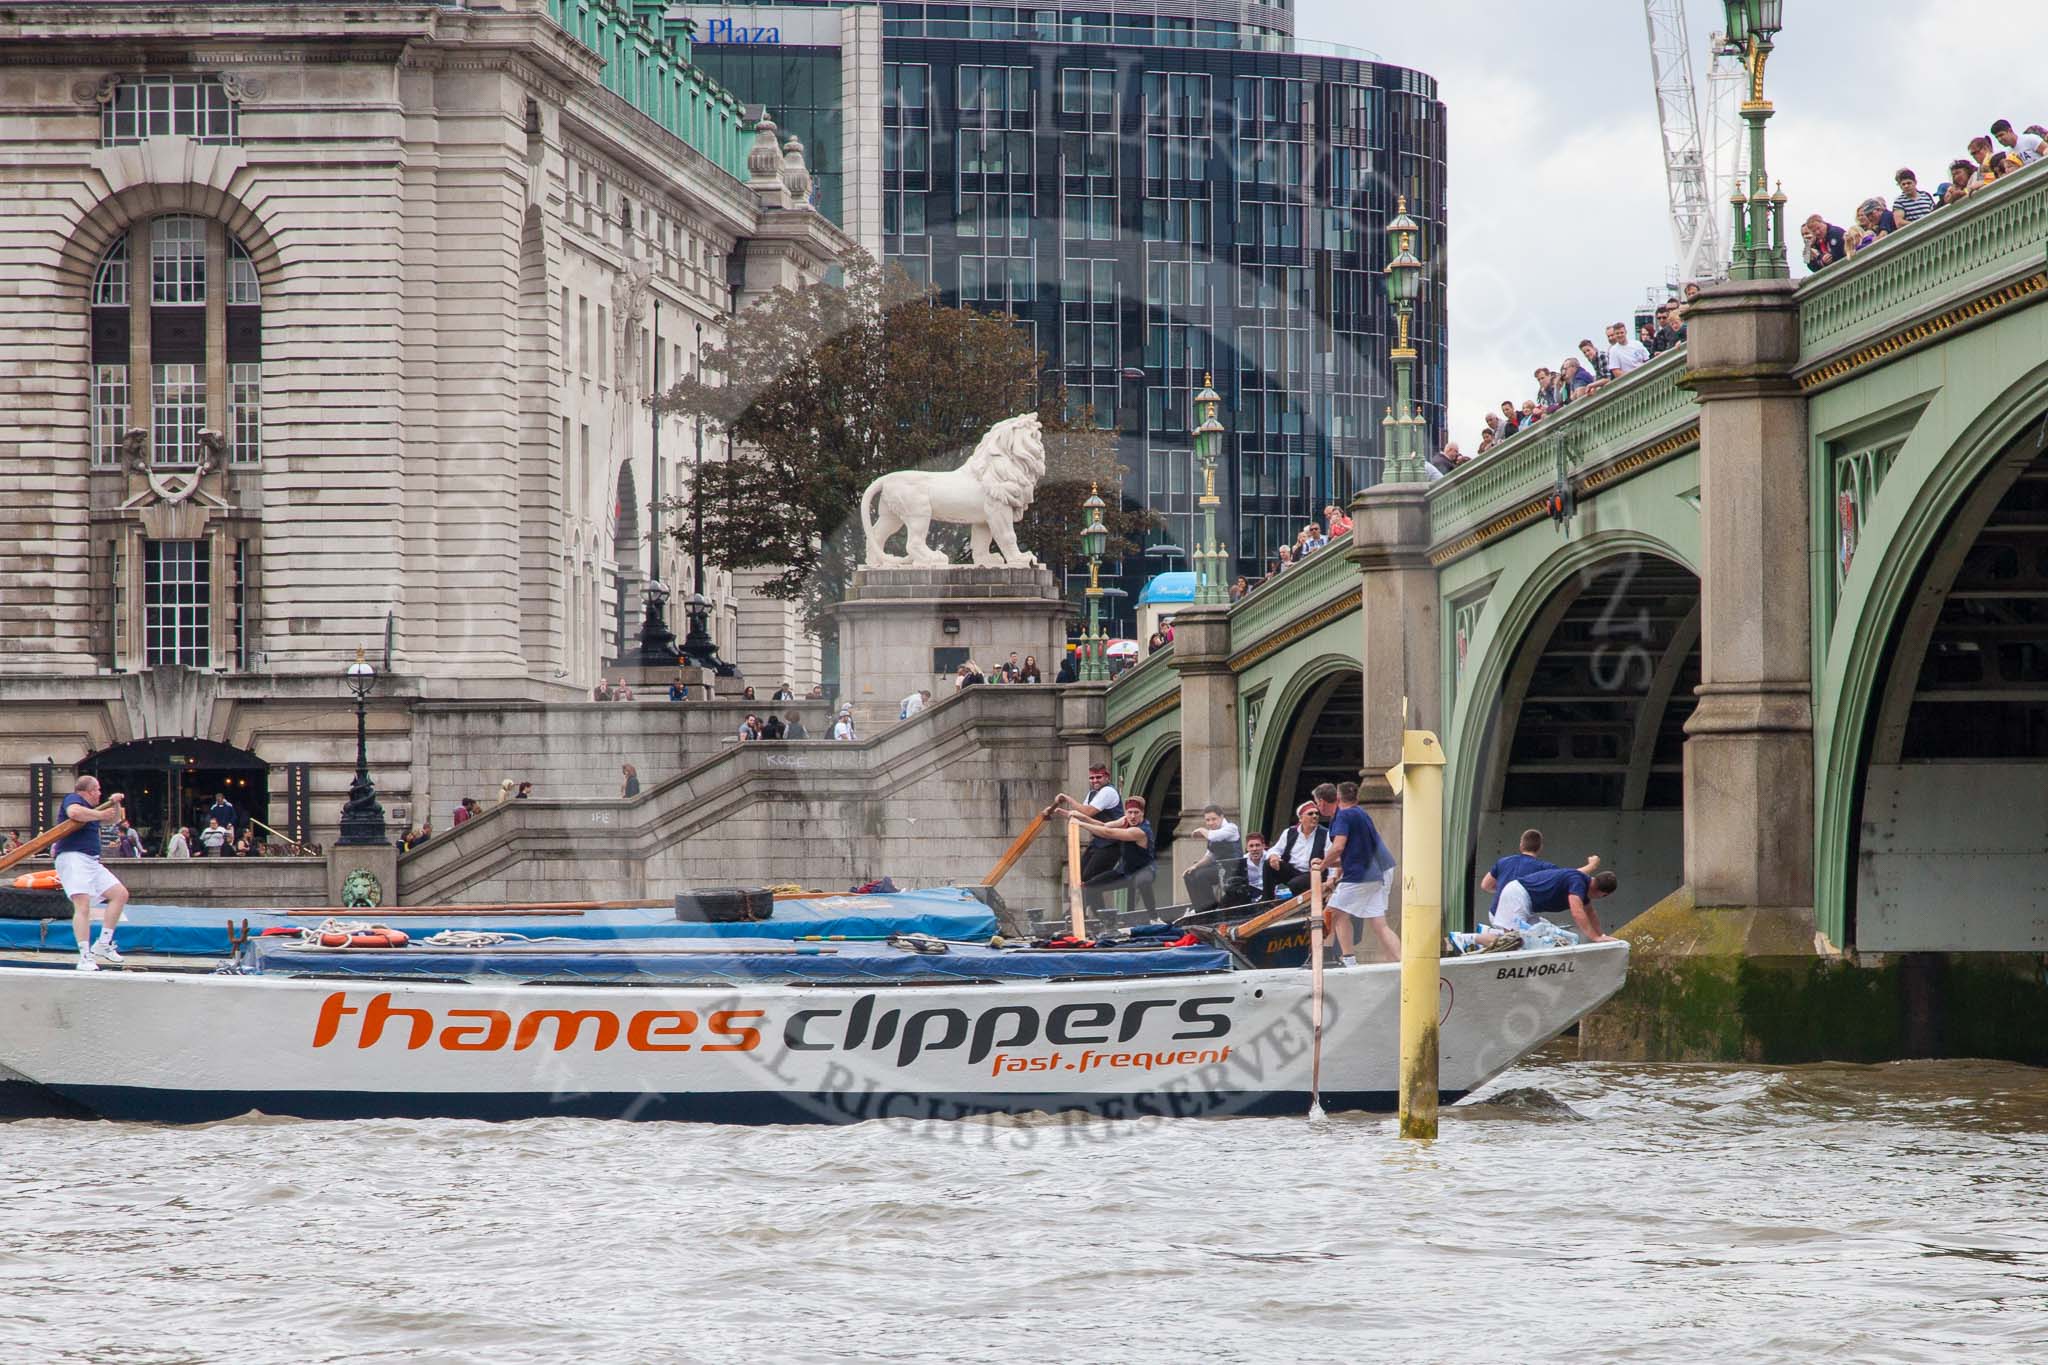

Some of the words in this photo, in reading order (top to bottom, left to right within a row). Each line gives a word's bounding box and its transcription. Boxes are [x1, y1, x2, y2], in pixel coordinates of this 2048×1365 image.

[707, 16, 780, 44] Plaza
[1266, 934, 1312, 953] DIAN
[1496, 961, 1576, 980] BALMORAL
[312, 991, 766, 1053] thames
[783, 993, 1236, 1067] clippers
